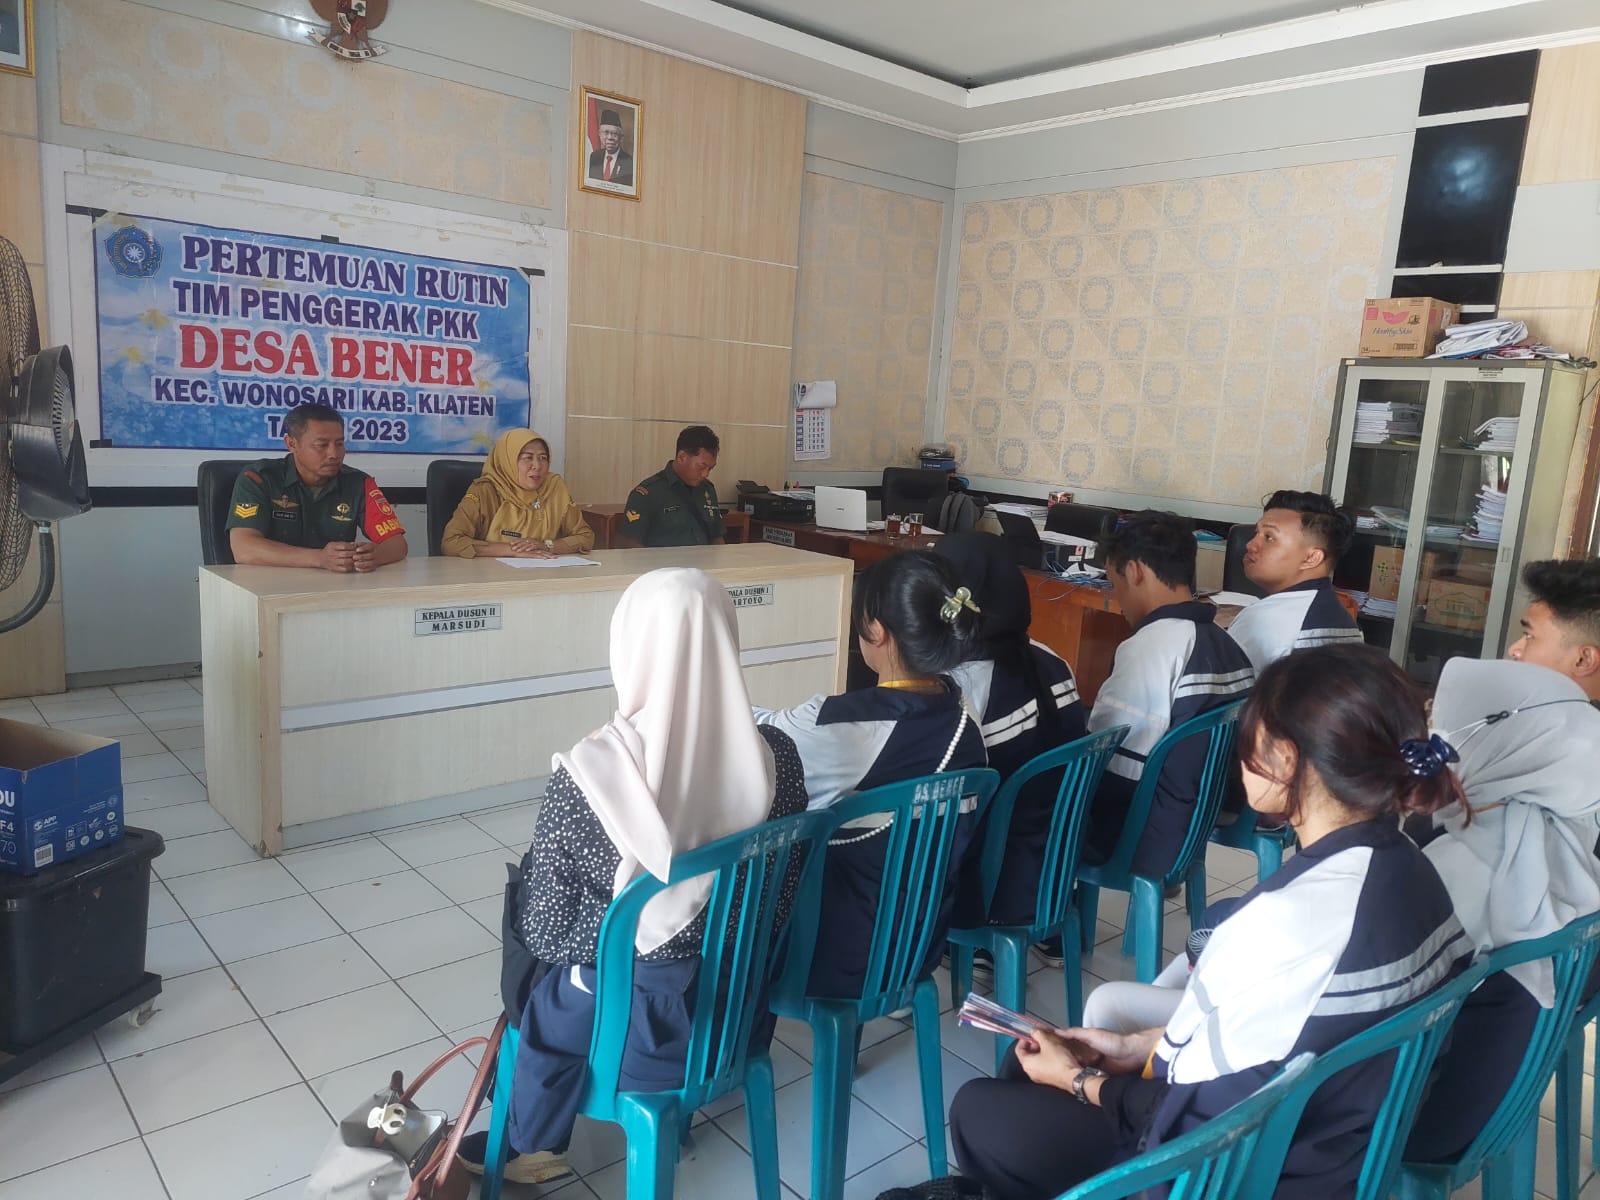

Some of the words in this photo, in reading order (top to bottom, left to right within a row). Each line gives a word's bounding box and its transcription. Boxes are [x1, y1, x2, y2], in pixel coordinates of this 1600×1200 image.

[183, 236, 406, 294] PERTEMUAN
[416, 266, 508, 306] RUTIN
[173, 280, 230, 316] TIM
[241, 287, 419, 335] PENGGERAK
[426, 308, 478, 339] PKK
[179, 325, 319, 376] DESA
[330, 336, 475, 386] BENER
[155, 378, 216, 404] KEC.
[223, 382, 354, 410] WONOSARI
[361, 389, 413, 412] KAB.
[418, 393, 494, 416] KLATEN
[351, 419, 407, 442] 2023
[422, 611, 455, 620] KEPALA
[457, 607, 487, 618] DUSUN
[432, 620, 485, 631] MARSUDI
